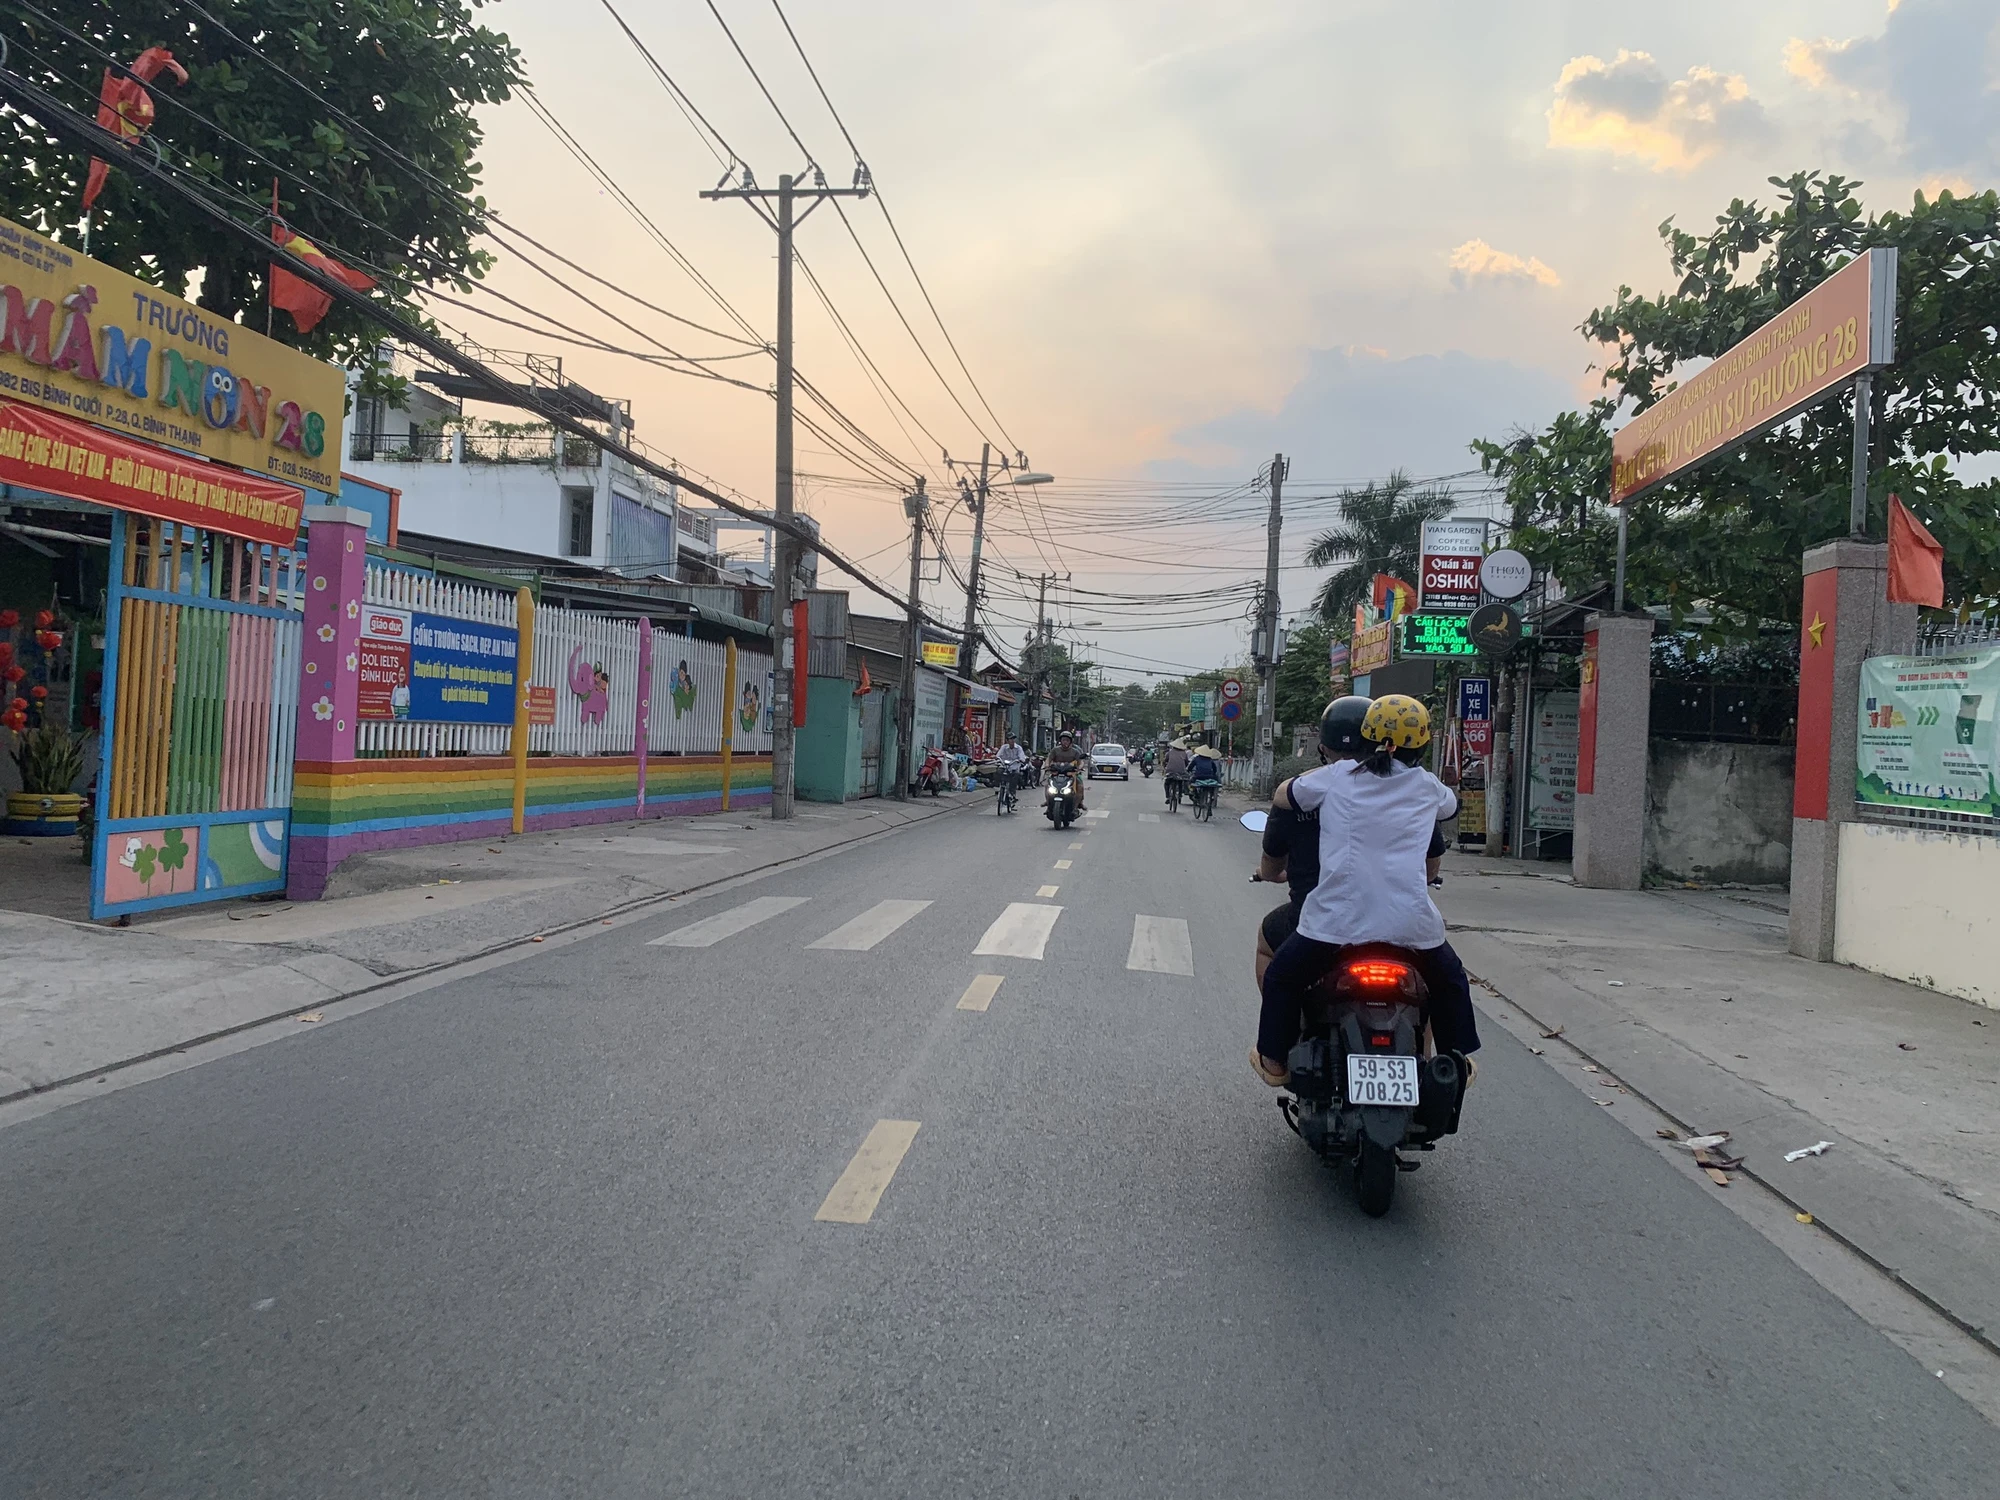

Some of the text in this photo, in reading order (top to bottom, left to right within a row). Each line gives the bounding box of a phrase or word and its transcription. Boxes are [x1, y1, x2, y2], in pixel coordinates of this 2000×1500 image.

[133, 292, 229, 357] TRƯỜNG
[0, 284, 151, 399] MẦM
[274, 400, 325, 458] 28
[1665, 400, 1682, 421] HUY
[1748, 334, 1771, 367] BÌNH
[1773, 306, 1811, 349] THẠNH
[1684, 399, 1724, 456] QUÂN
[1726, 377, 1747, 432] SỰ
[1749, 333, 1828, 417] PHƯỜNG
[1832, 316, 1858, 369] 28
[20, 377, 40, 397] BIS
[43, 383, 71, 407] BÌNH
[131, 414, 141, 429] Q.
[143, 415, 166, 437] BÌNH
[169, 424, 201, 447] THẠNH
[68, 441, 88, 480] VIỆT
[268, 456, 281, 472] ĐT:
[1427, 526, 1481, 534] VIAN GARDEN
[1431, 558, 1474, 571] Quán ăn
[1489, 565, 1525, 575] THƠM
[1425, 573, 1479, 589] OSHIKI
[371, 617, 402, 634] giáo dục
[1424, 627, 1458, 637] BI DA
[413, 622, 433, 647] CỔNG
[434, 629, 460, 651] TRƯỜNG
[501, 638, 516, 658] TOÀN
[362, 653, 399, 668] DOL IELTS
[382, 671, 397, 685] LỰC
[1466, 682, 1483, 694] BÃI
[1468, 699, 1480, 709] XE
[1358, 1059, 1406, 1080] 59-S3
[1354, 1081, 1413, 1102] 708.25
